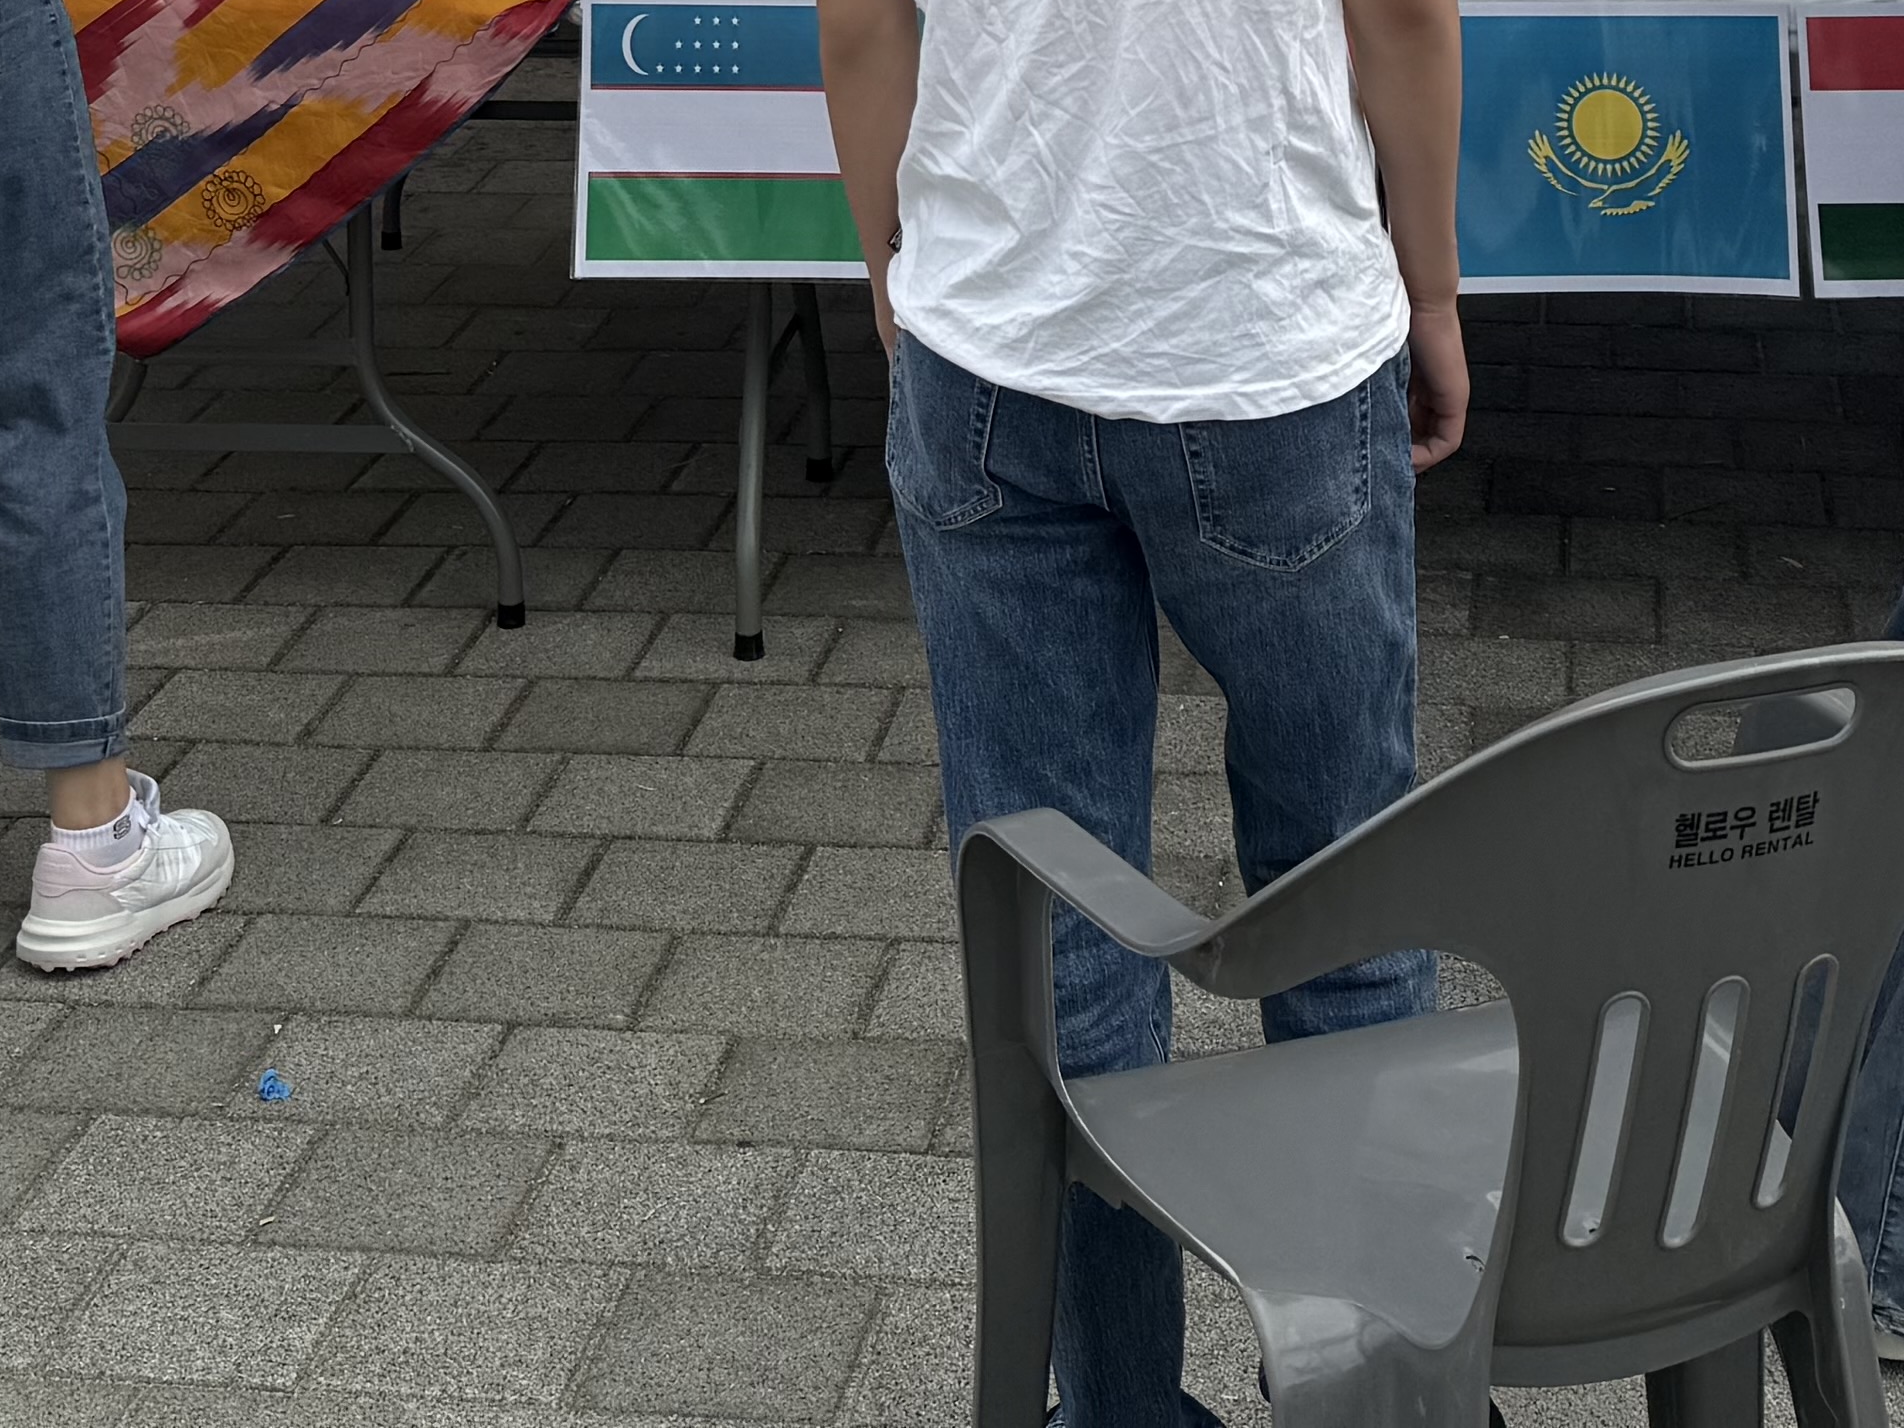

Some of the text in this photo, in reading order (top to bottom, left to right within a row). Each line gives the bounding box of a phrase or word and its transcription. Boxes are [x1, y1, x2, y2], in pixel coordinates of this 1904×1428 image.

[1674, 791, 1819, 849] 헬로우 렌탈
[1669, 831, 1814, 869] HELLO RENTAL
